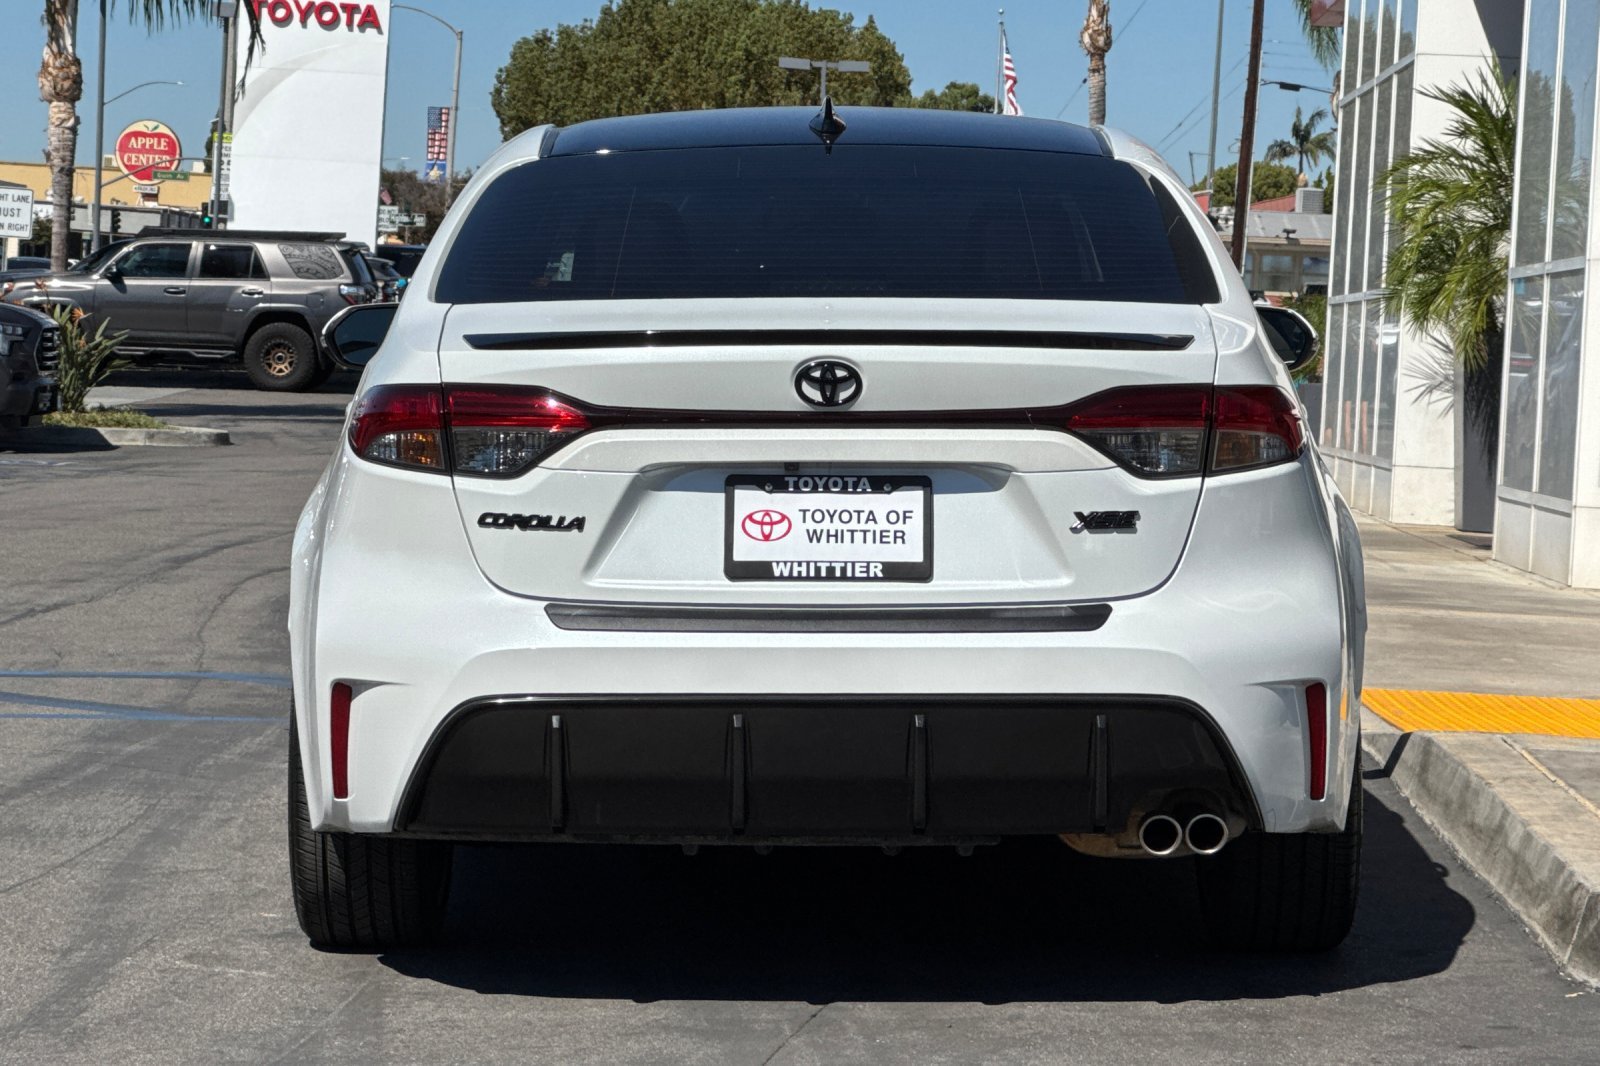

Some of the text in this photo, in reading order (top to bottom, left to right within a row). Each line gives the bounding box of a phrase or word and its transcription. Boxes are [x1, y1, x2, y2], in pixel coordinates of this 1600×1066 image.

[128, 136, 169, 150] APPLE
[123, 153, 171, 167] CENTER
[12, 194, 31, 204] LANE
[7, 222, 29, 232] RIGHT
[784, 476, 872, 492] TOYOTA
[477, 512, 586, 533] COROLLA
[798, 508, 914, 525] TOYOTA OF
[806, 528, 906, 545] WHITTIER
[772, 561, 884, 578] WHITTIER
